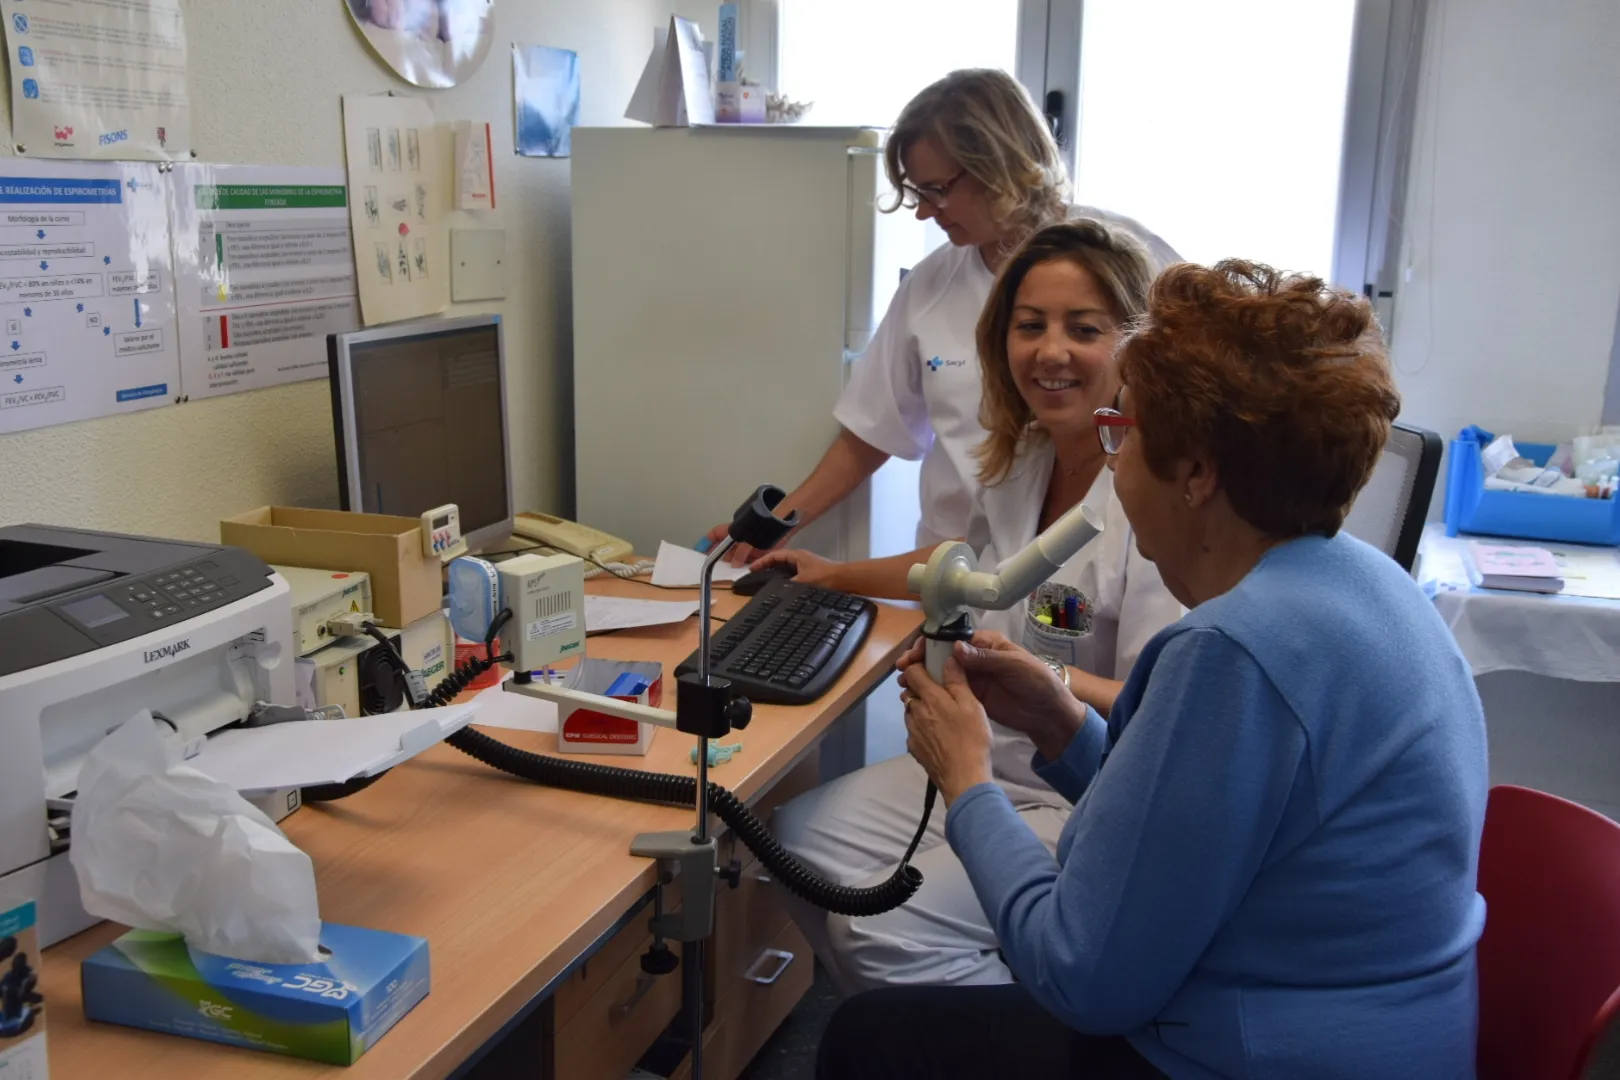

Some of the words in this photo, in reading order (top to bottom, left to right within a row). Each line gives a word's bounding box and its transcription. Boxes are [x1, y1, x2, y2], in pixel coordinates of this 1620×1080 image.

[99, 129, 128, 146] FISONS
[5, 184, 53, 195] REALIZACIÓN
[53, 187, 63, 196] DE
[64, 186, 117, 197] ESPIROMETRÍAS
[144, 639, 191, 664] LEXMARK
[422, 661, 445, 677] AEGER
